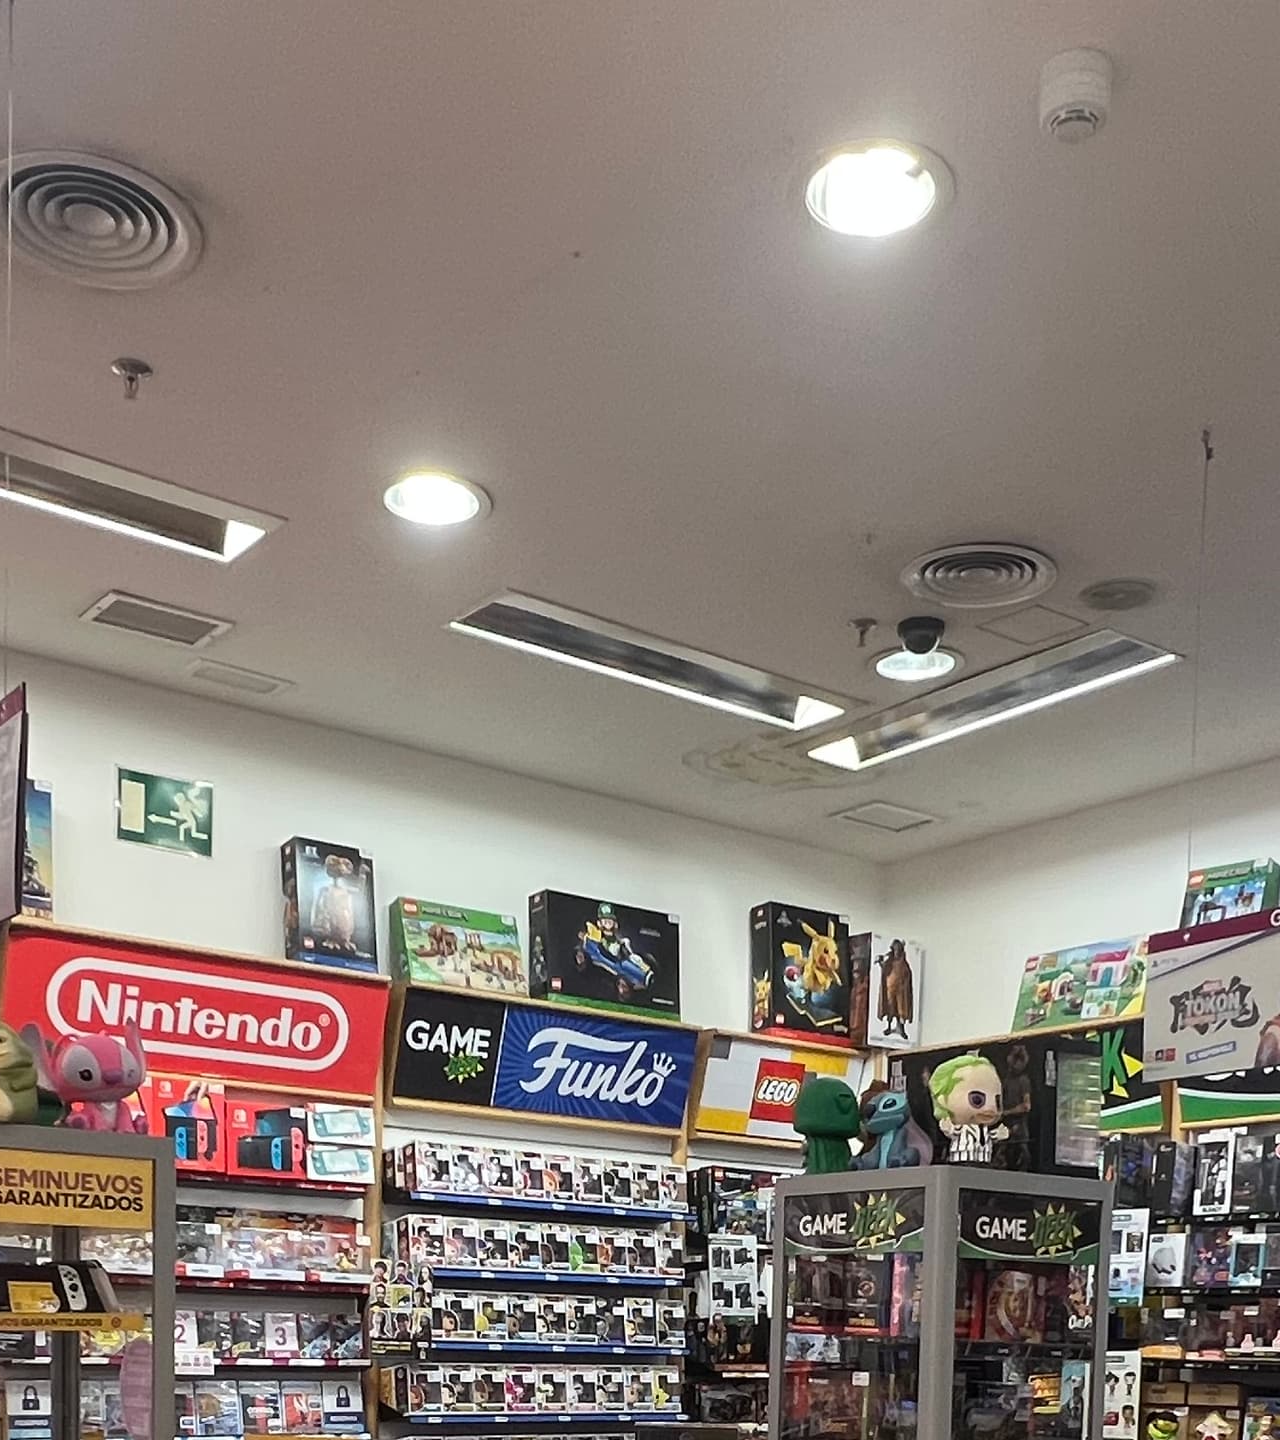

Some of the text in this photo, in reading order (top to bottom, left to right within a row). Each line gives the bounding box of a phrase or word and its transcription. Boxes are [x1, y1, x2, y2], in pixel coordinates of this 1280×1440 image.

[77, 979, 322, 1052] Nintendo
[406, 1020, 492, 1060] GAME
[519, 1027, 666, 1108] Funko
[757, 1079, 798, 1105] LEGO
[799, 1213, 848, 1237] GAME
[975, 1216, 1027, 1242] GAME
[22, 1318, 103, 1328] GARANTIZADOS
